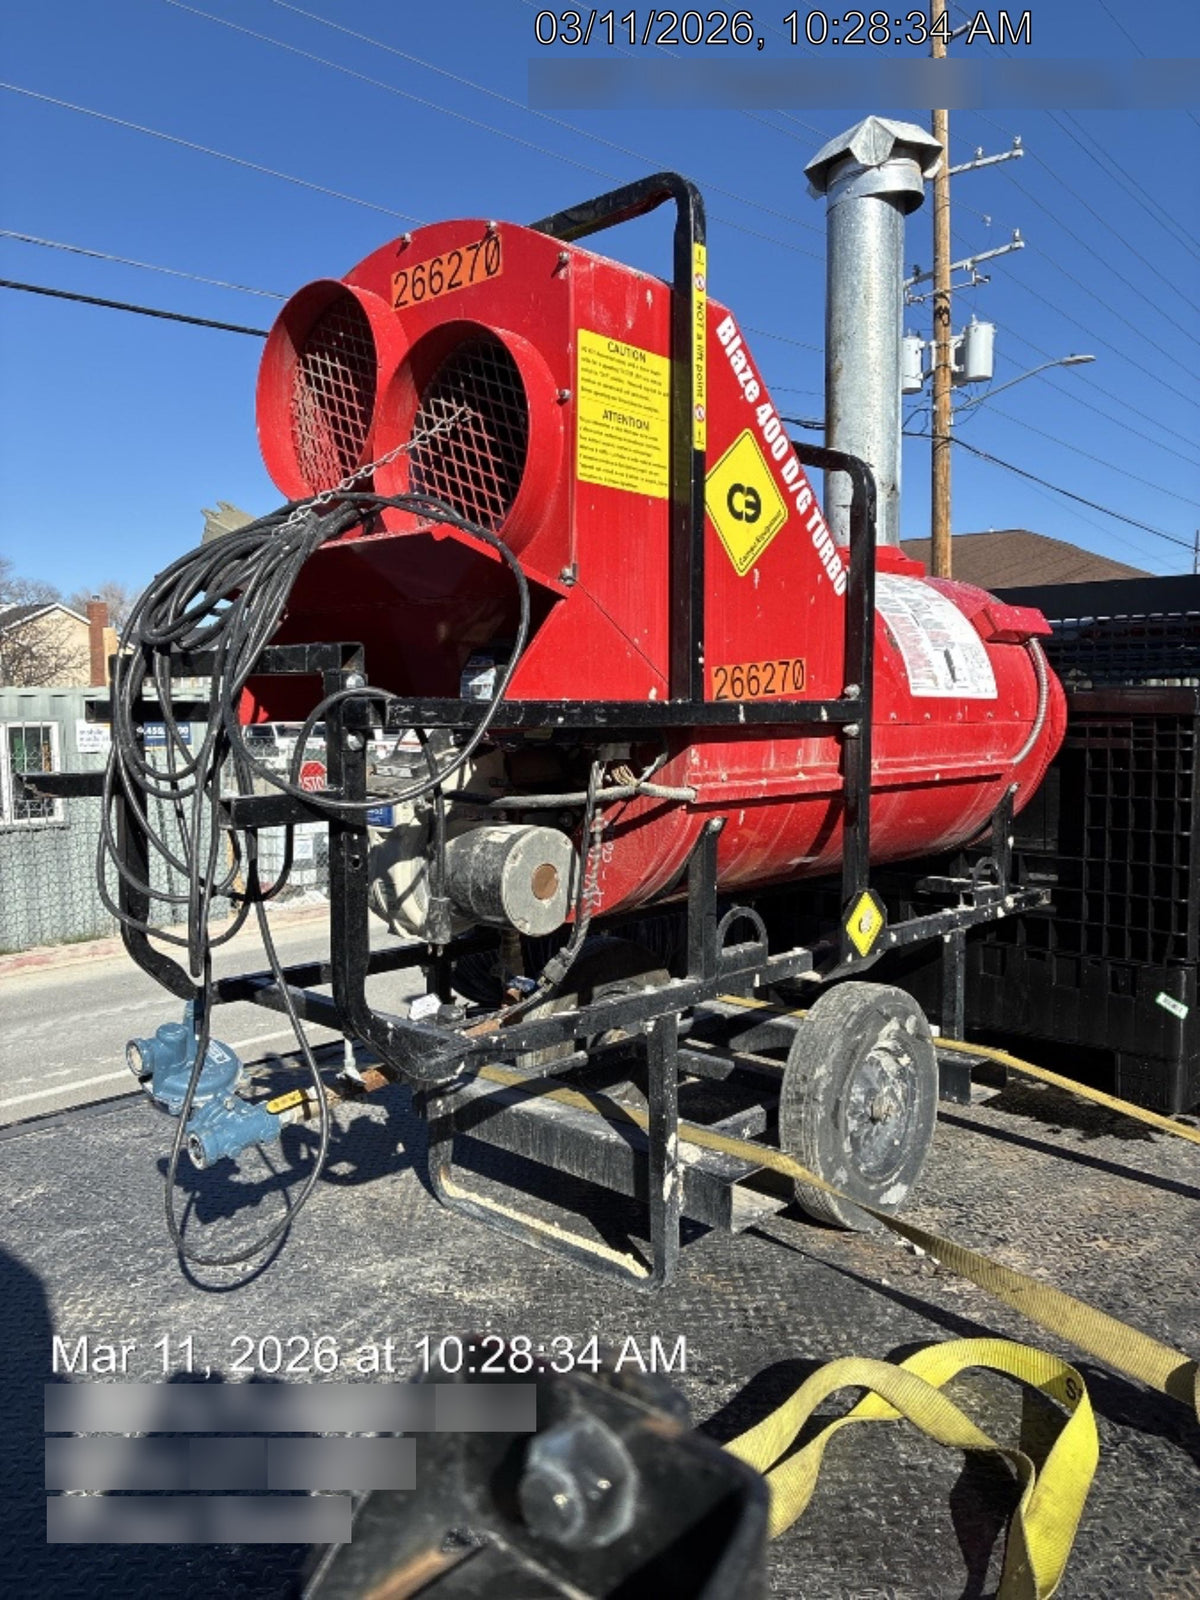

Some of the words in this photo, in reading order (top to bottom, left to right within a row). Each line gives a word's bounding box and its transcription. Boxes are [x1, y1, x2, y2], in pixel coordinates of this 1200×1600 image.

[394, 235, 500, 309] 266270
[696, 300, 704, 331] NOT
[607, 340, 647, 363] CAUTION
[696, 344, 704, 362] lift
[695, 364, 704, 398] point
[602, 409, 650, 432] ATTENTION
[715, 314, 761, 404] Blaze
[755, 402, 789, 462] 400
[780, 456, 813, 515] D/G
[806, 506, 847, 597] TURBO
[713, 658, 805, 701] 266270
